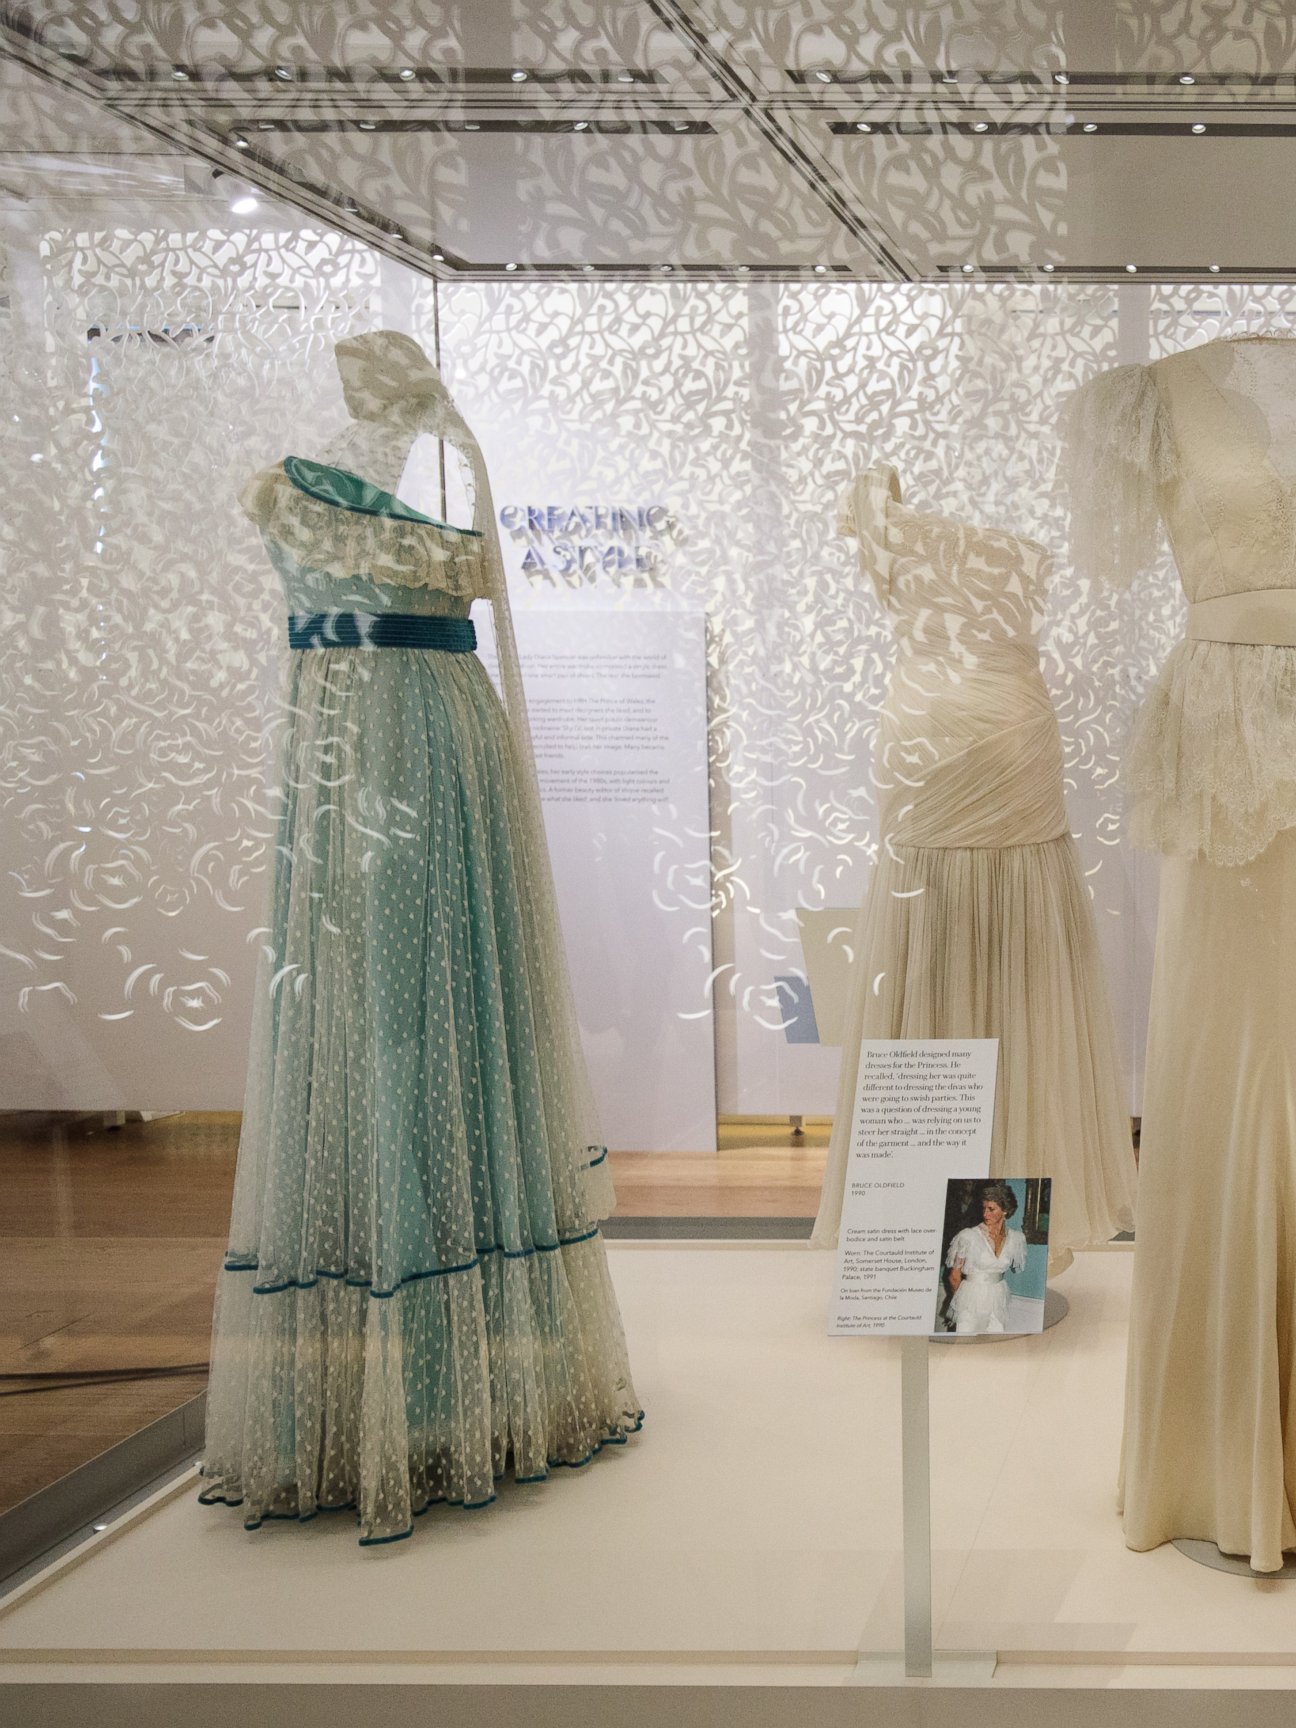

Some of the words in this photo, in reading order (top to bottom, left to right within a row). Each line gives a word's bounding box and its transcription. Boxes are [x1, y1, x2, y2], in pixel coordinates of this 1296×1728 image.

[918, 1050, 951, 1059] designed
[864, 1072, 895, 1081] recalled,
[929, 1072, 942, 1080] her
[957, 1072, 977, 1082] quite
[862, 1083, 894, 1091] different
[895, 1083, 903, 1091] to
[903, 1083, 934, 1093] dressing
[934, 1083, 947, 1091] the
[947, 1083, 967, 1091] divas
[967, 1083, 983, 1091] who
[880, 1094, 901, 1104] going
[901, 1094, 909, 1102] to
[910, 1094, 930, 1102] swish
[931, 1094, 958, 1104] parties.
[959, 1094, 976, 1102] This
[881, 1105, 913, 1115] question
[921, 1105, 953, 1115] dressing
[958, 1107, 982, 1115] young
[887, 1116, 903, 1124] who
[926, 1116, 952, 1126] relying
[973, 1116, 981, 1124] to
[890, 1128, 918, 1137] straight
[948, 1128, 977, 1137] concept
[878, 1139, 909, 1148] garment
